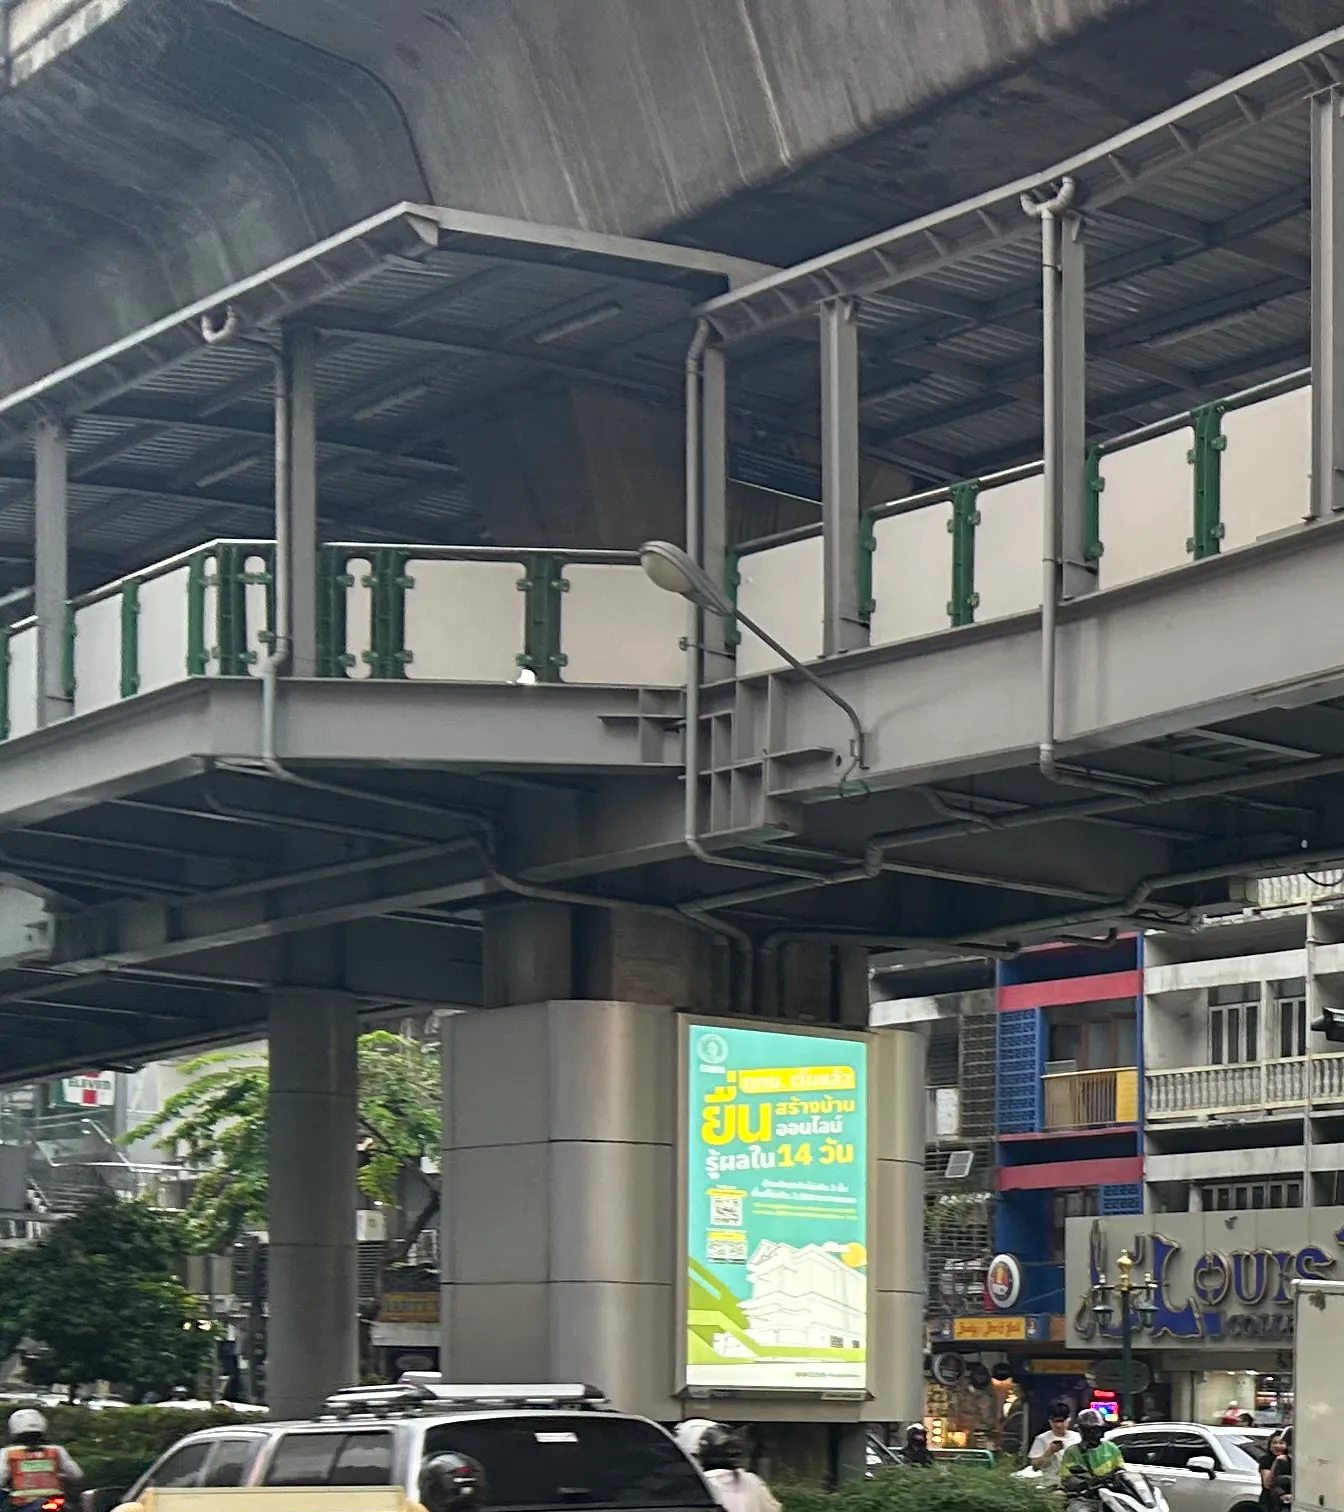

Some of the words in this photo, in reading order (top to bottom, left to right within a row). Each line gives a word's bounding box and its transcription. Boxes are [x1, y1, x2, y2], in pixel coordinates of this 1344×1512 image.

[775, 1094, 856, 1116] สร้างบ้าน
[775, 1114, 844, 1137] ออนไลน์
[705, 1144, 776, 1180] รู้ผลใน
[777, 1142, 813, 1168] 14
[818, 1136, 854, 1165] วัน
